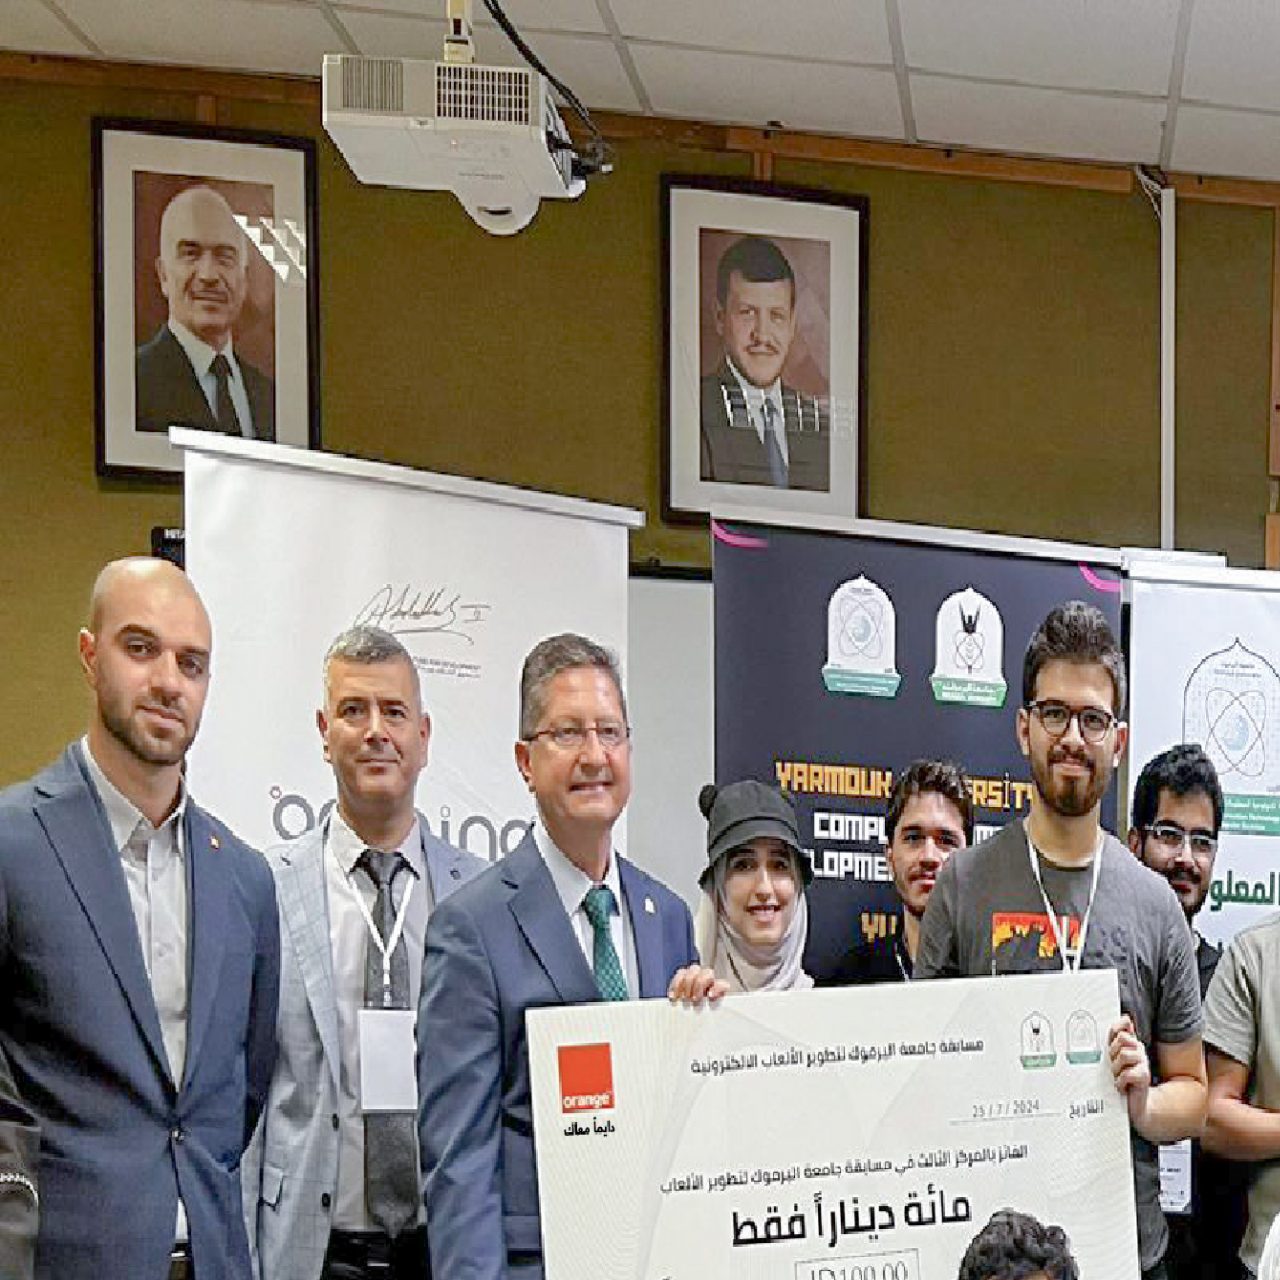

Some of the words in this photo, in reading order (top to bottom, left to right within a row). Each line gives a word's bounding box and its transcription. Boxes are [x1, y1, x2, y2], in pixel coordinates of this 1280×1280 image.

[775, 761, 893, 799] YARMOUK
[563, 1094, 611, 1109] orange
[904, 1183, 972, 1226] مائة
[732, 1203, 806, 1247] فقط
